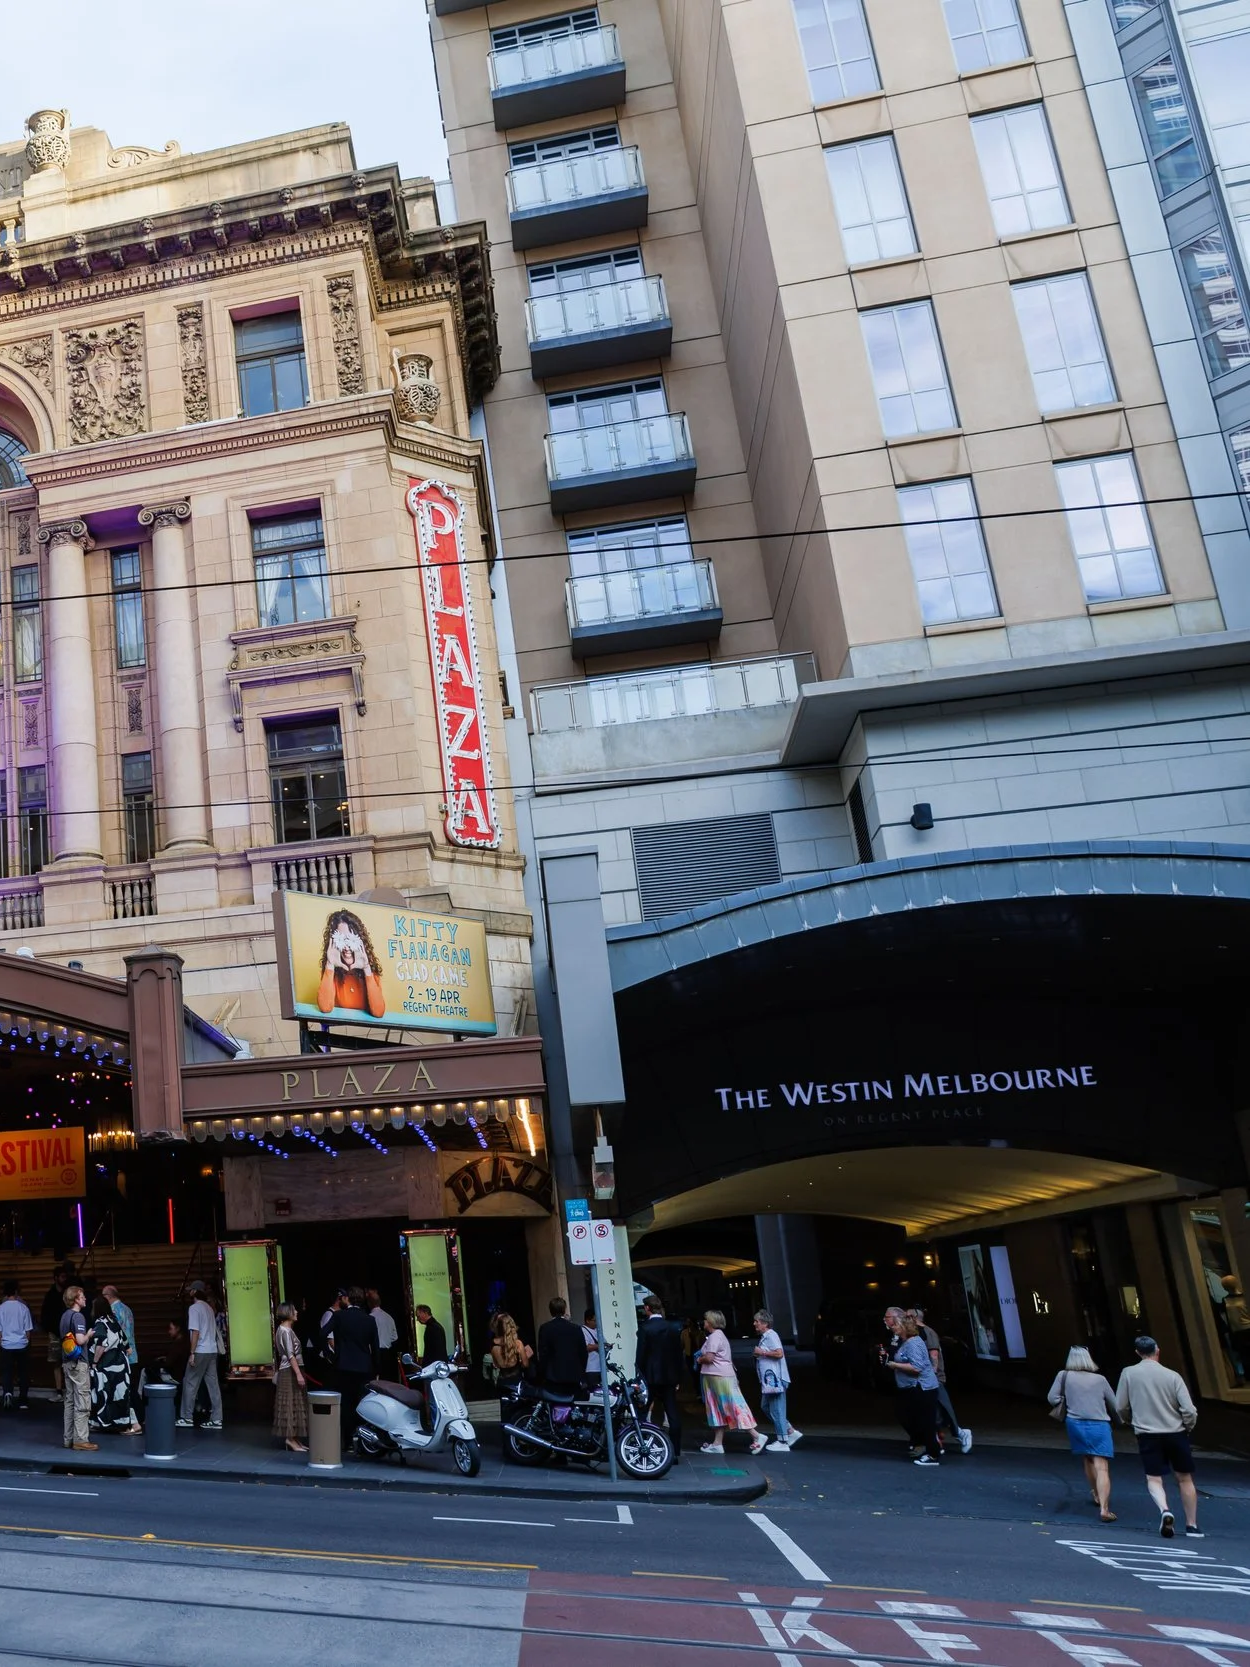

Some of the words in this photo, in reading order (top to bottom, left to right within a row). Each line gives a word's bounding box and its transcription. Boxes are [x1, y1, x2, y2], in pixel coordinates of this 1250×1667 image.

[421, 500, 492, 834] PLAZA
[393, 914, 458, 944] KITTY
[387, 939, 471, 967] FLANAGAN
[396, 961, 429, 983] GLAD
[431, 965, 469, 988] GAME
[407, 985, 415, 999] 2
[425, 988, 437, 1002] 19
[439, 989, 461, 1004] APR
[402, 1001, 432, 1013] REGENT
[435, 1004, 469, 1018] THEATRE
[280, 1059, 438, 1102] PLAZA
[715, 1087, 772, 1111] THE
[779, 1079, 893, 1108] WESTIN
[904, 1065, 1098, 1098] MELBOURNE
[823, 1116, 847, 1127] ON
[856, 1110, 925, 1125] REGENT
[931, 1106, 984, 1120] PLACE
[608, 1268, 622, 1350] ORIGINAL
